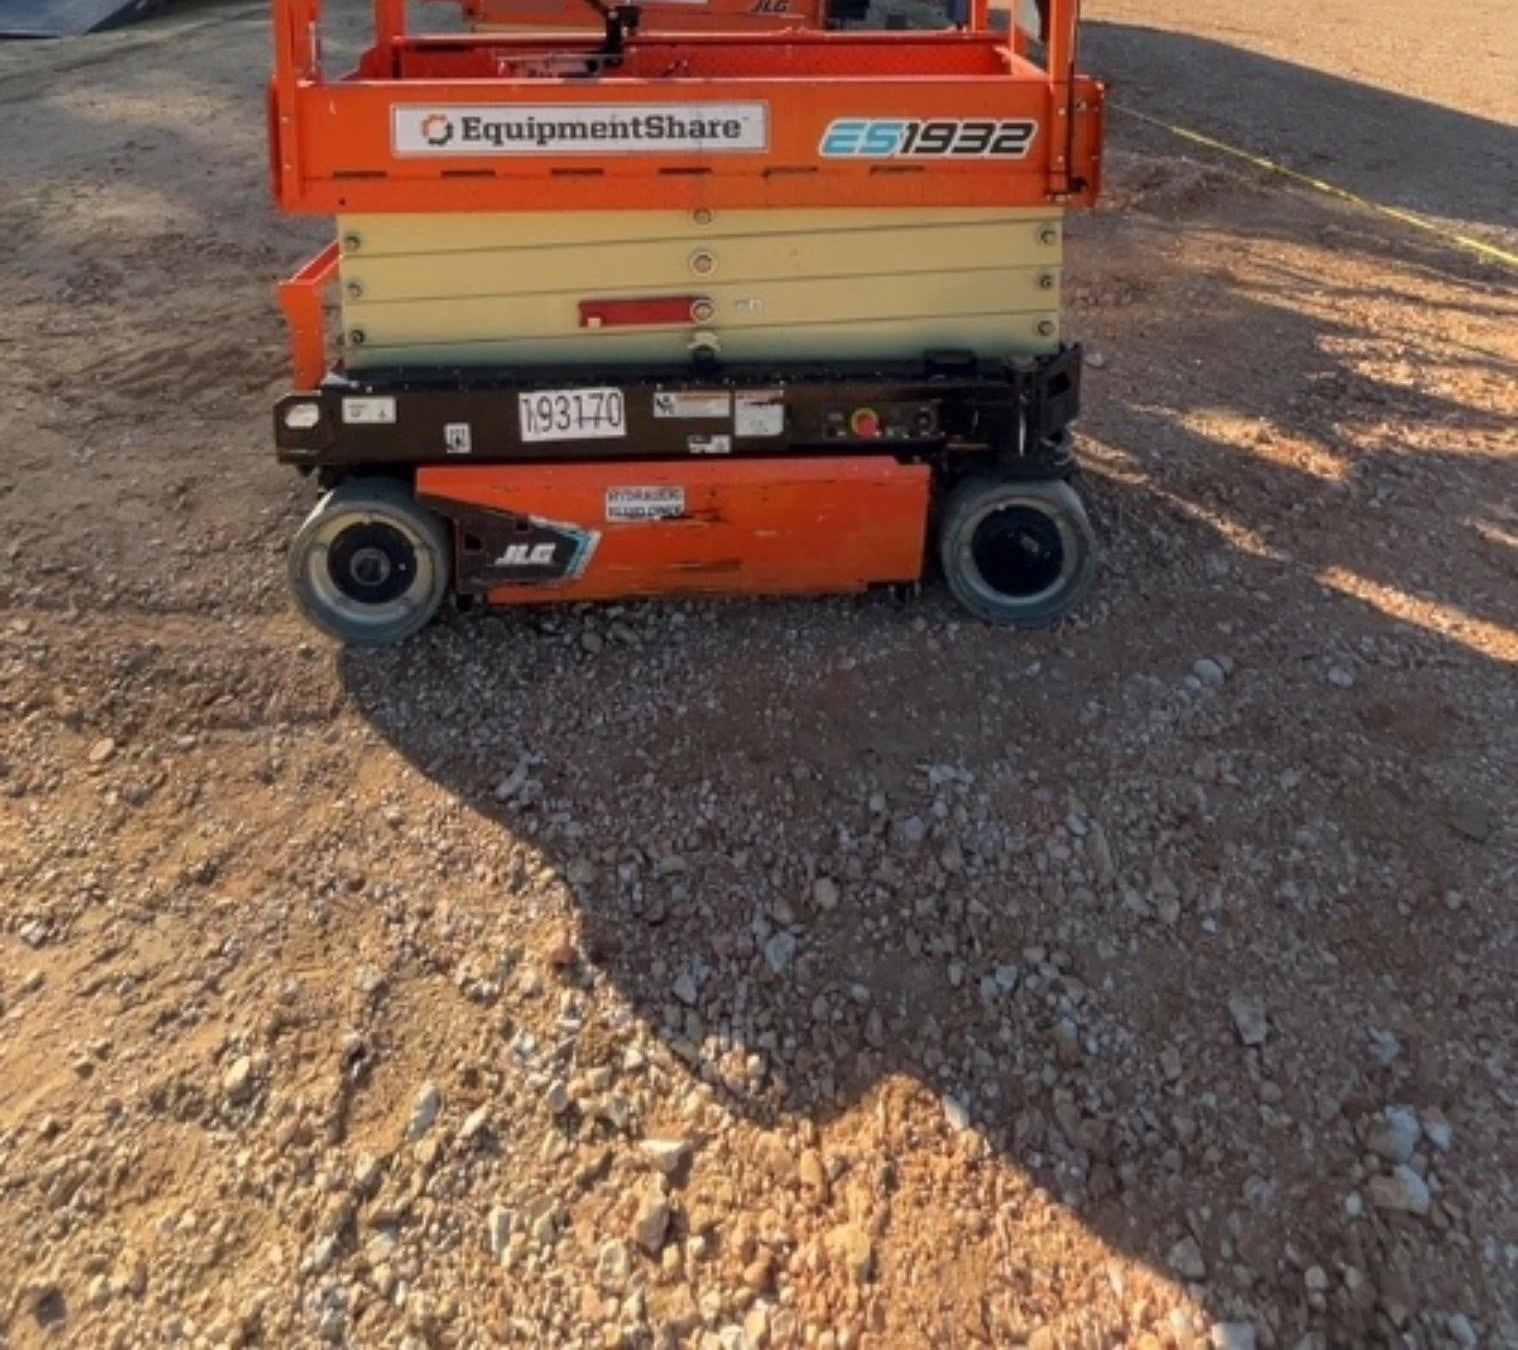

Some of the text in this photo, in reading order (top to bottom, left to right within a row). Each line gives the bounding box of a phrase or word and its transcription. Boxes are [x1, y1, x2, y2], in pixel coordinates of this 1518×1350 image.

[461, 115, 742, 146] EquipmentShare
[821, 121, 1035, 154] ES1932
[520, 392, 621, 434] 193170
[495, 542, 556, 565] JLG
